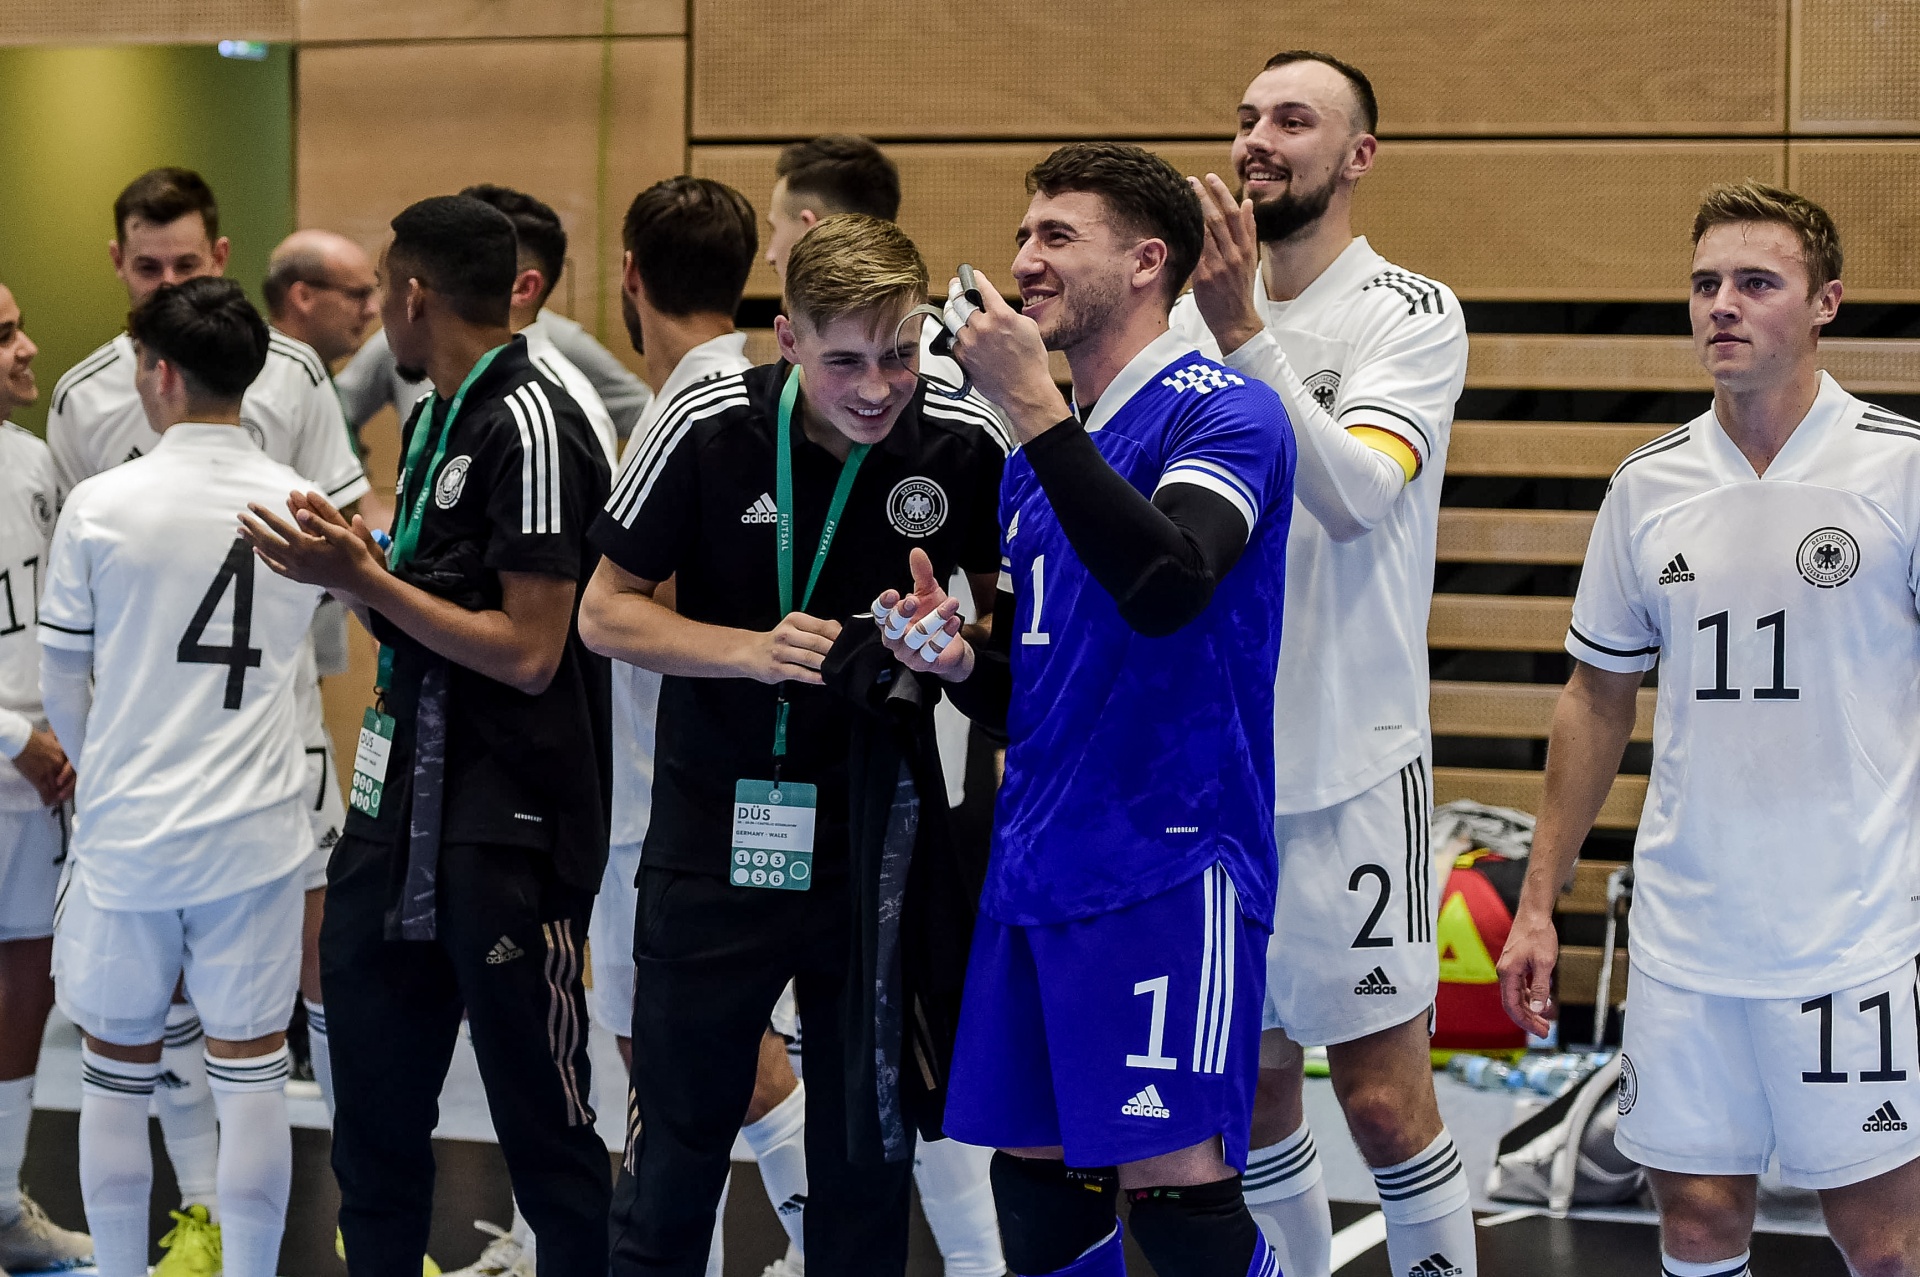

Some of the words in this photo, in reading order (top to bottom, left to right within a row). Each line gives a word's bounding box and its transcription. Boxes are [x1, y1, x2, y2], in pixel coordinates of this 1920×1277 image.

[901, 485, 935, 496] DEUTSCHER
[741, 512, 777, 523] adida
[781, 513, 789, 551] FUTSAL
[819, 520, 835, 556] FUTSAL
[1811, 535, 1847, 546] DEUTSCHER
[1659, 571, 1695, 585] adidas
[1805, 563, 1849, 580] FUSSBALL-BUND
[1022, 554, 1050, 644] 1
[177, 538, 261, 710] 4
[1696, 608, 1800, 700] 11
[305, 746, 326, 811] 7
[738, 805, 770, 821] DÜS
[739, 854, 746, 863] 1
[757, 855, 763, 864] 2
[774, 856, 781, 865] 3
[755, 873, 762, 882] 5
[773, 874, 780, 883] 6
[1349, 864, 1393, 948] 2
[1354, 984, 1397, 995] adidas
[1126, 975, 1178, 1070] 1
[1801, 991, 1907, 1083] 11
[1121, 1103, 1170, 1119] adidas
[1862, 1121, 1908, 1132] adidas
